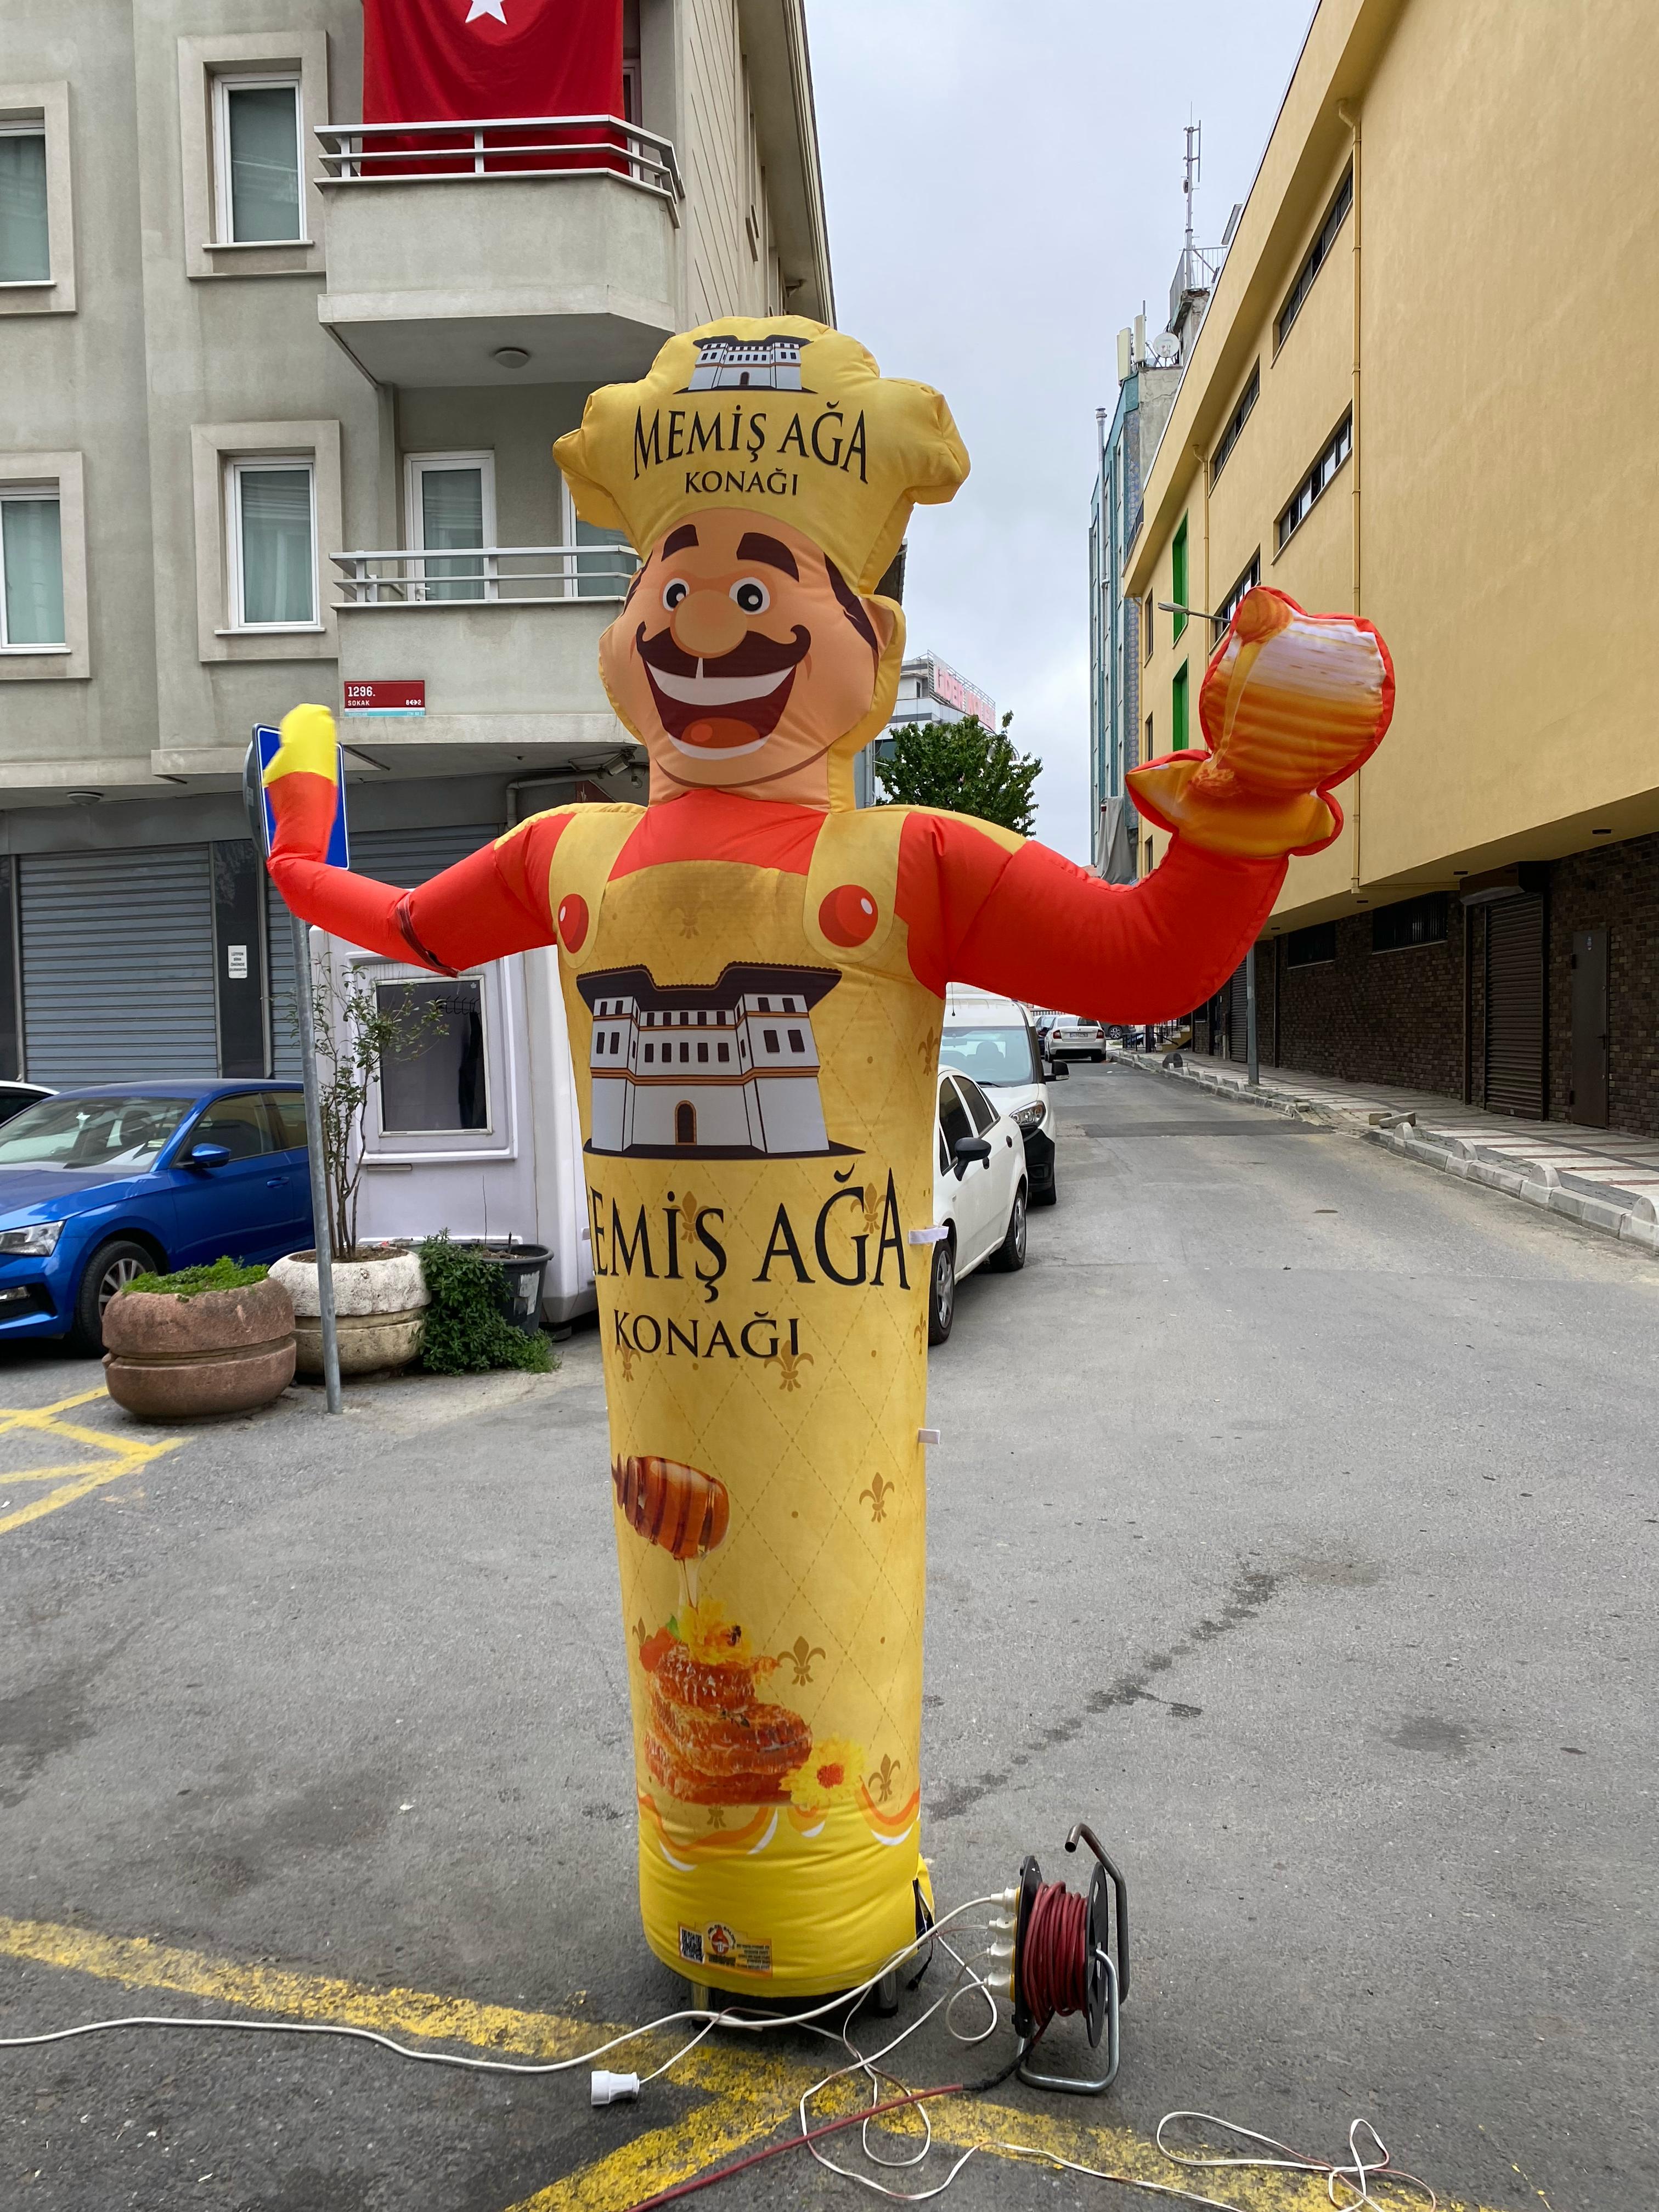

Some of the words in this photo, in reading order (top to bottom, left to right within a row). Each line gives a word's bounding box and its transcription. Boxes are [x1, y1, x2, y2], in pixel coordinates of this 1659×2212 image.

[633, 404, 766, 480] MEMİŞ
[777, 400, 868, 484] AĞA
[685, 468, 798, 496] KONAĞI
[347, 686, 376, 697] 1296.
[586, 1178, 727, 1304] EMİŞ
[752, 1163, 911, 1291] AĞA
[613, 1309, 800, 1359] KONAĞI
